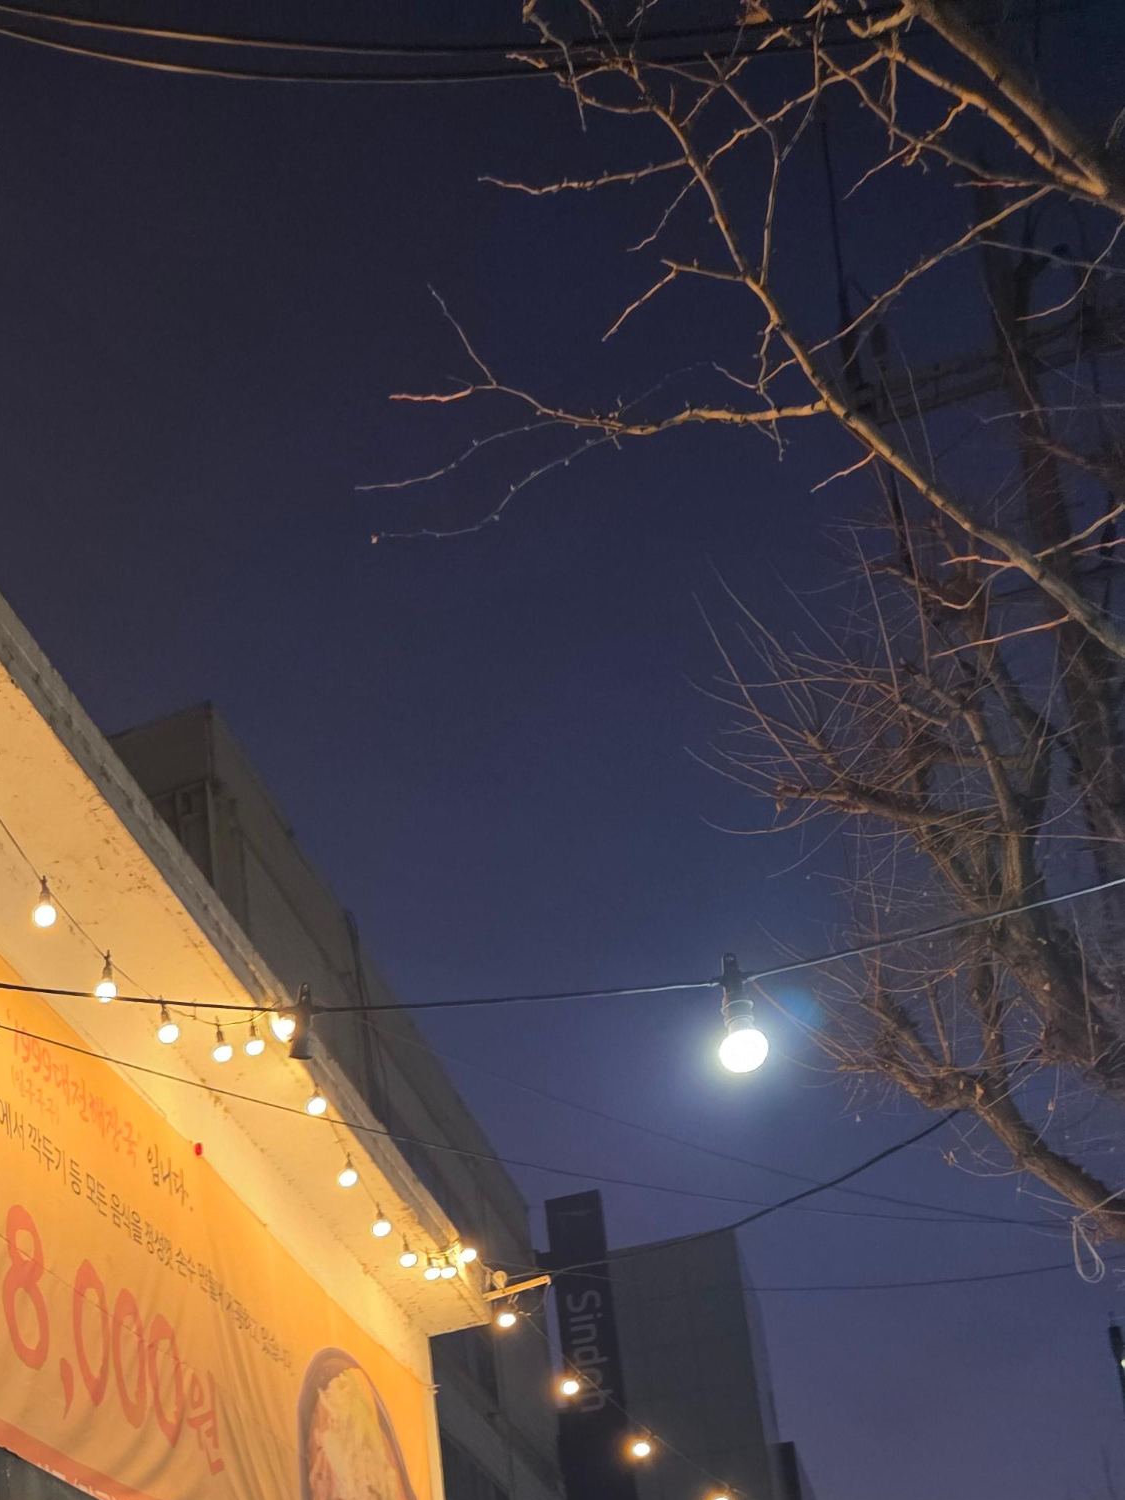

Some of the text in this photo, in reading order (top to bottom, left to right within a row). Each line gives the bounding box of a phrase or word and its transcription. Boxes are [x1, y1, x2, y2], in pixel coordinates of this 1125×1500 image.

[27, 1123, 67, 1186] 깍두기
[70, 1157, 83, 1197] 등
[85, 1171, 108, 1217] 모든
[110, 1192, 143, 1246] 음식을
[146, 1143, 194, 1212] 입니다.
[1, 1203, 225, 1477] 8,000원
[566, 1289, 614, 1413] Sindoh
